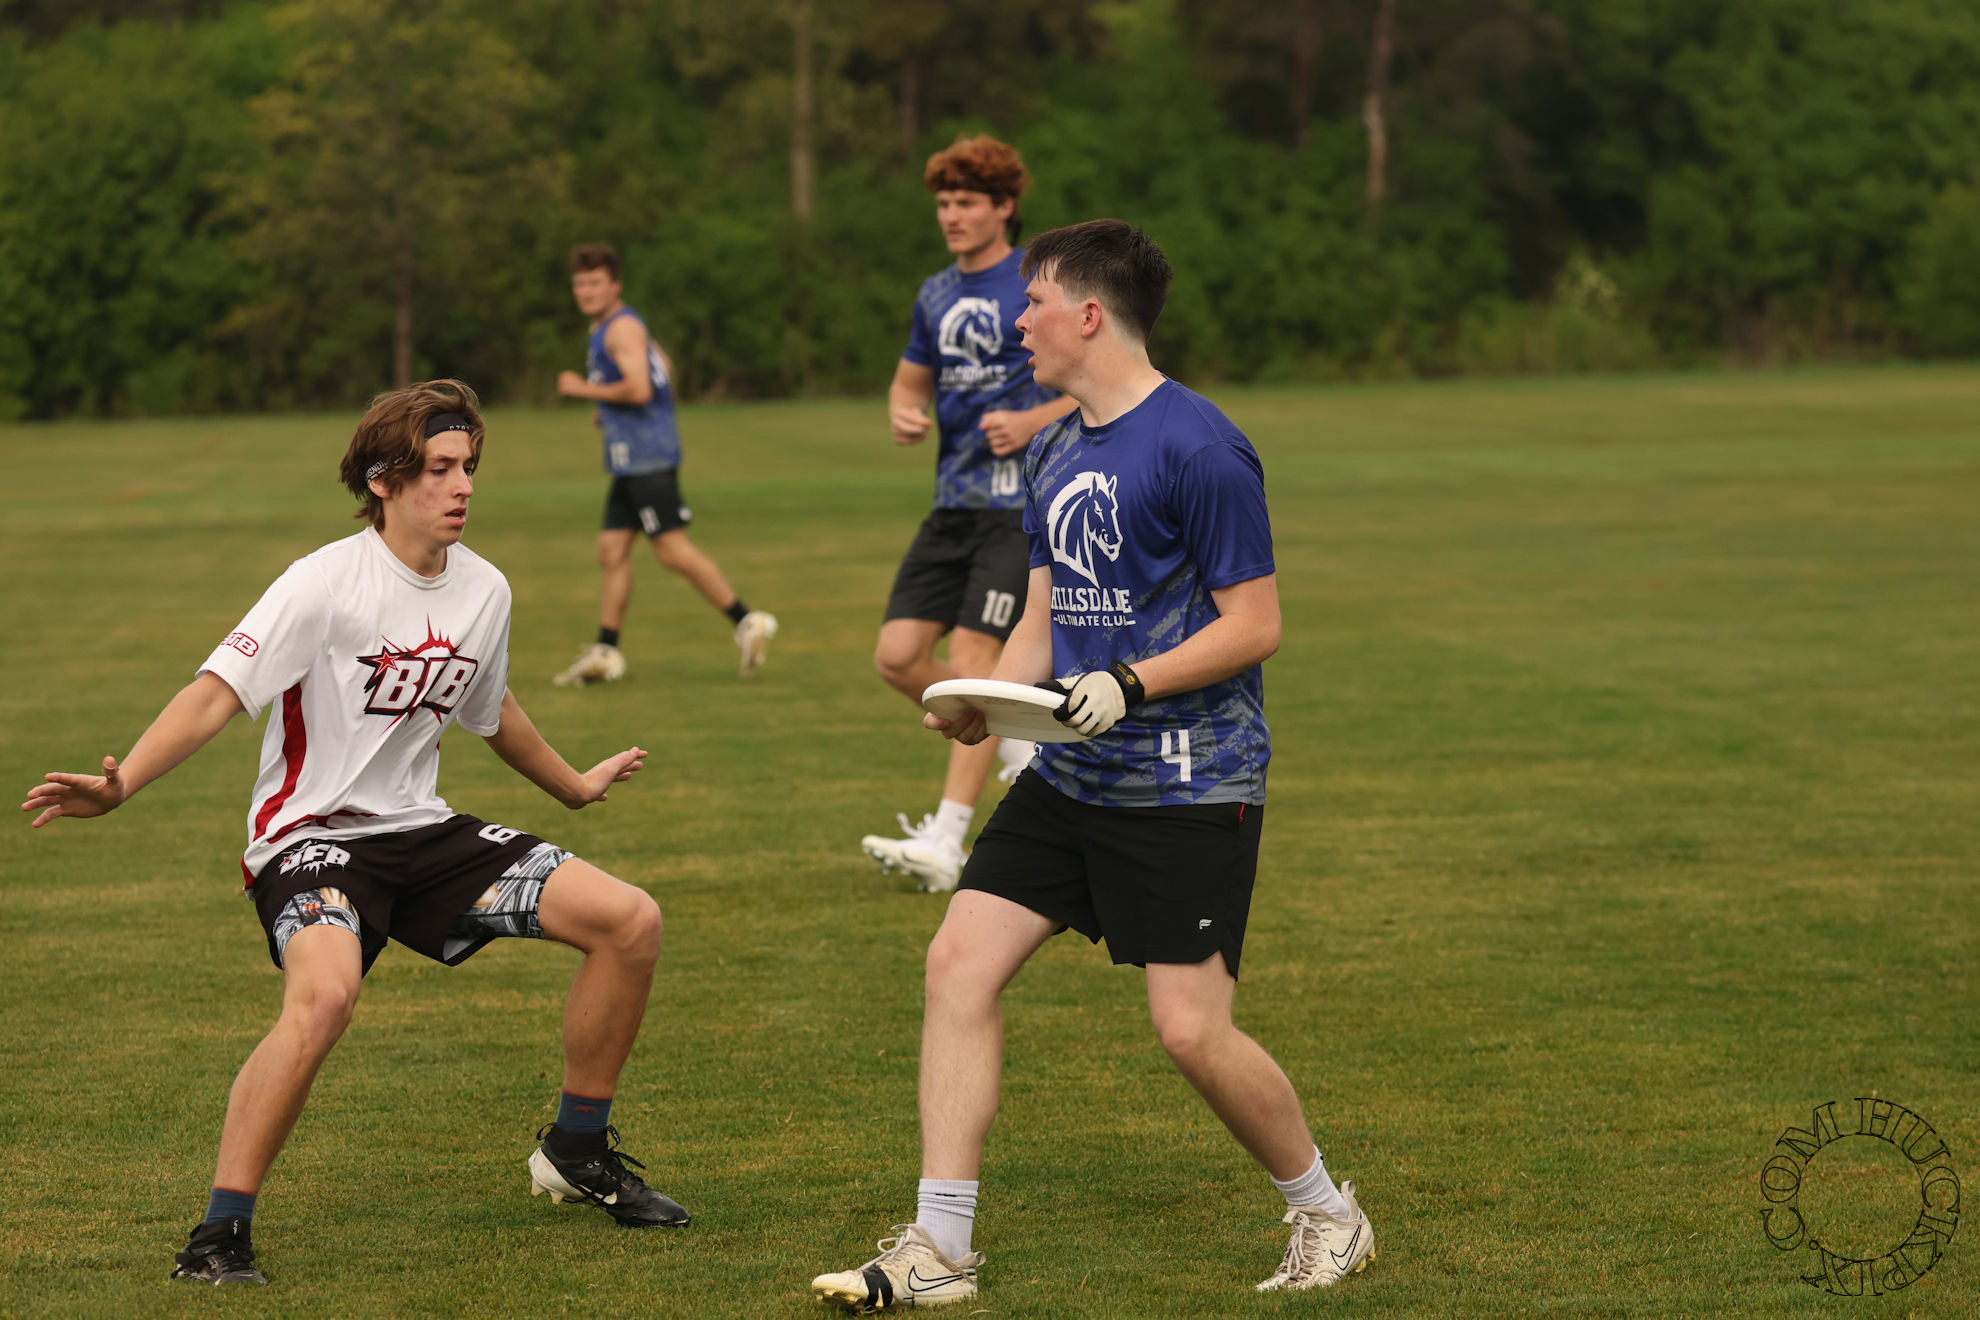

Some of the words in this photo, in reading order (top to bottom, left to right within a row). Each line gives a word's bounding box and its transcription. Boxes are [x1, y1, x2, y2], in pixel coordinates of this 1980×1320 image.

[991, 459, 1018, 497] 10
[981, 589, 1016, 628] 10
[1161, 729, 1192, 782] 4
